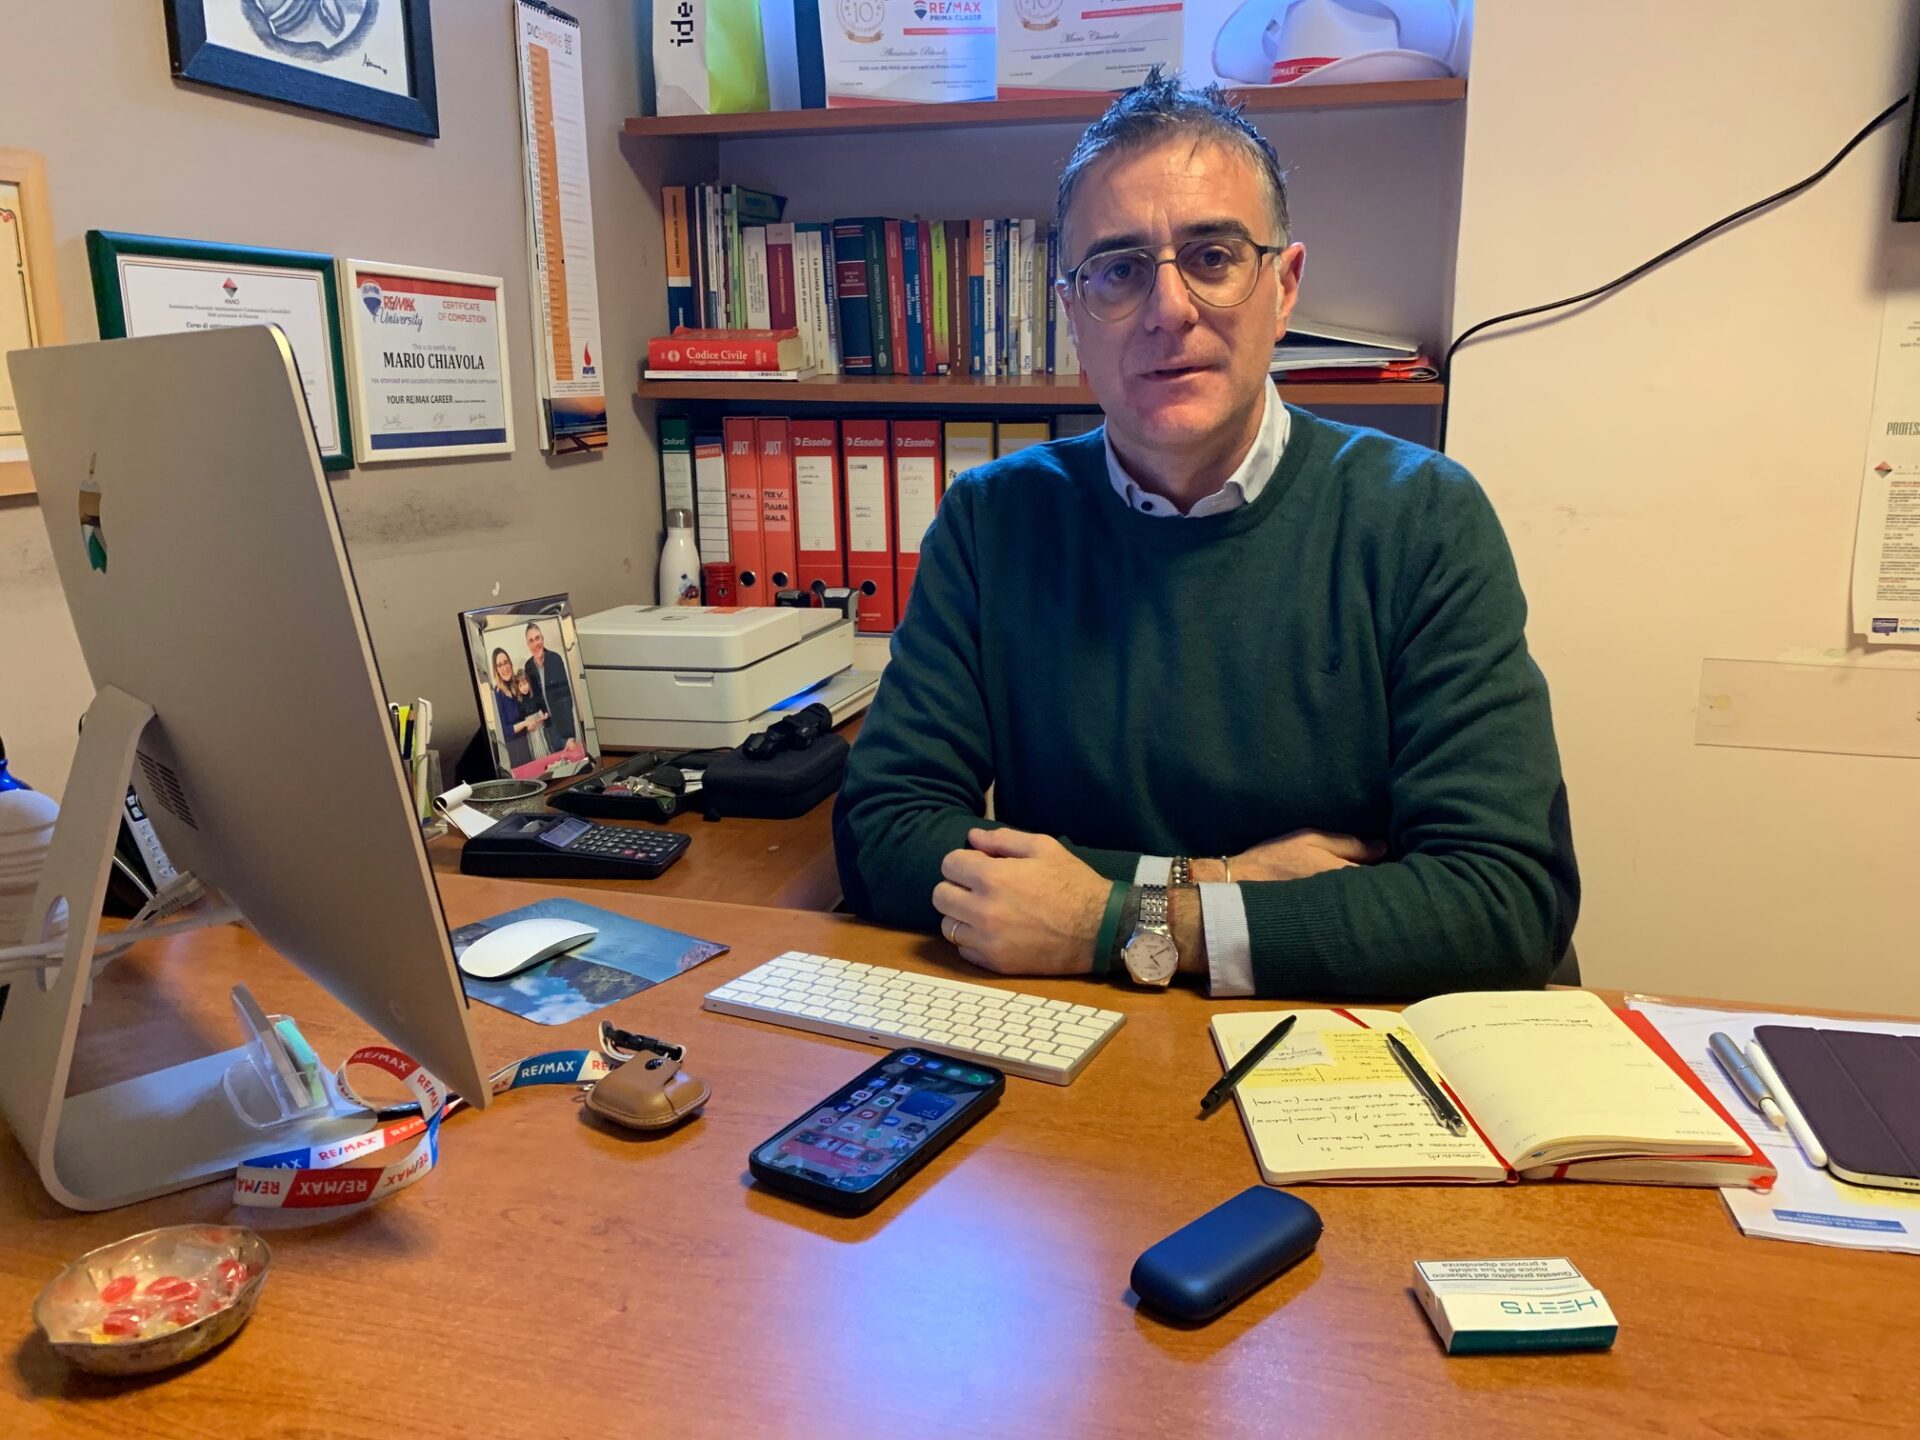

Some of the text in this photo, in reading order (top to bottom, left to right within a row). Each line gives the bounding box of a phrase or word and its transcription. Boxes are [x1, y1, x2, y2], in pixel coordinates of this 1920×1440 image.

[929, 1, 981, 14] RE/MAX
[526, 22, 563, 48] DICEMBRE
[384, 296, 416, 311] RE/MAX
[443, 301, 481, 311] CERTIFICATE
[373, 307, 422, 332] University
[438, 313, 487, 323] OF COMPLETION
[383, 352, 485, 370] MARIO CHIAVOLA
[686, 348, 748, 360] Codice Civile
[387, 395, 404, 404] YOUR
[431, 395, 453, 403] CAREER
[1886, 422, 1920, 436] PROFES
[663, 438, 685, 446] Oxford
[731, 441, 749, 456] JUST
[764, 441, 782, 456] JUST
[353, 1051, 409, 1071] RE/MAX
[521, 1061, 575, 1078] RE/MAX
[318, 1136, 378, 1161] RE/MAX
[383, 1150, 429, 1187] RE/MAX
[299, 1179, 368, 1196] RE/MAX
[1493, 1272, 1535, 1280] prodotto
[1500, 1296, 1598, 1315] HEETS
